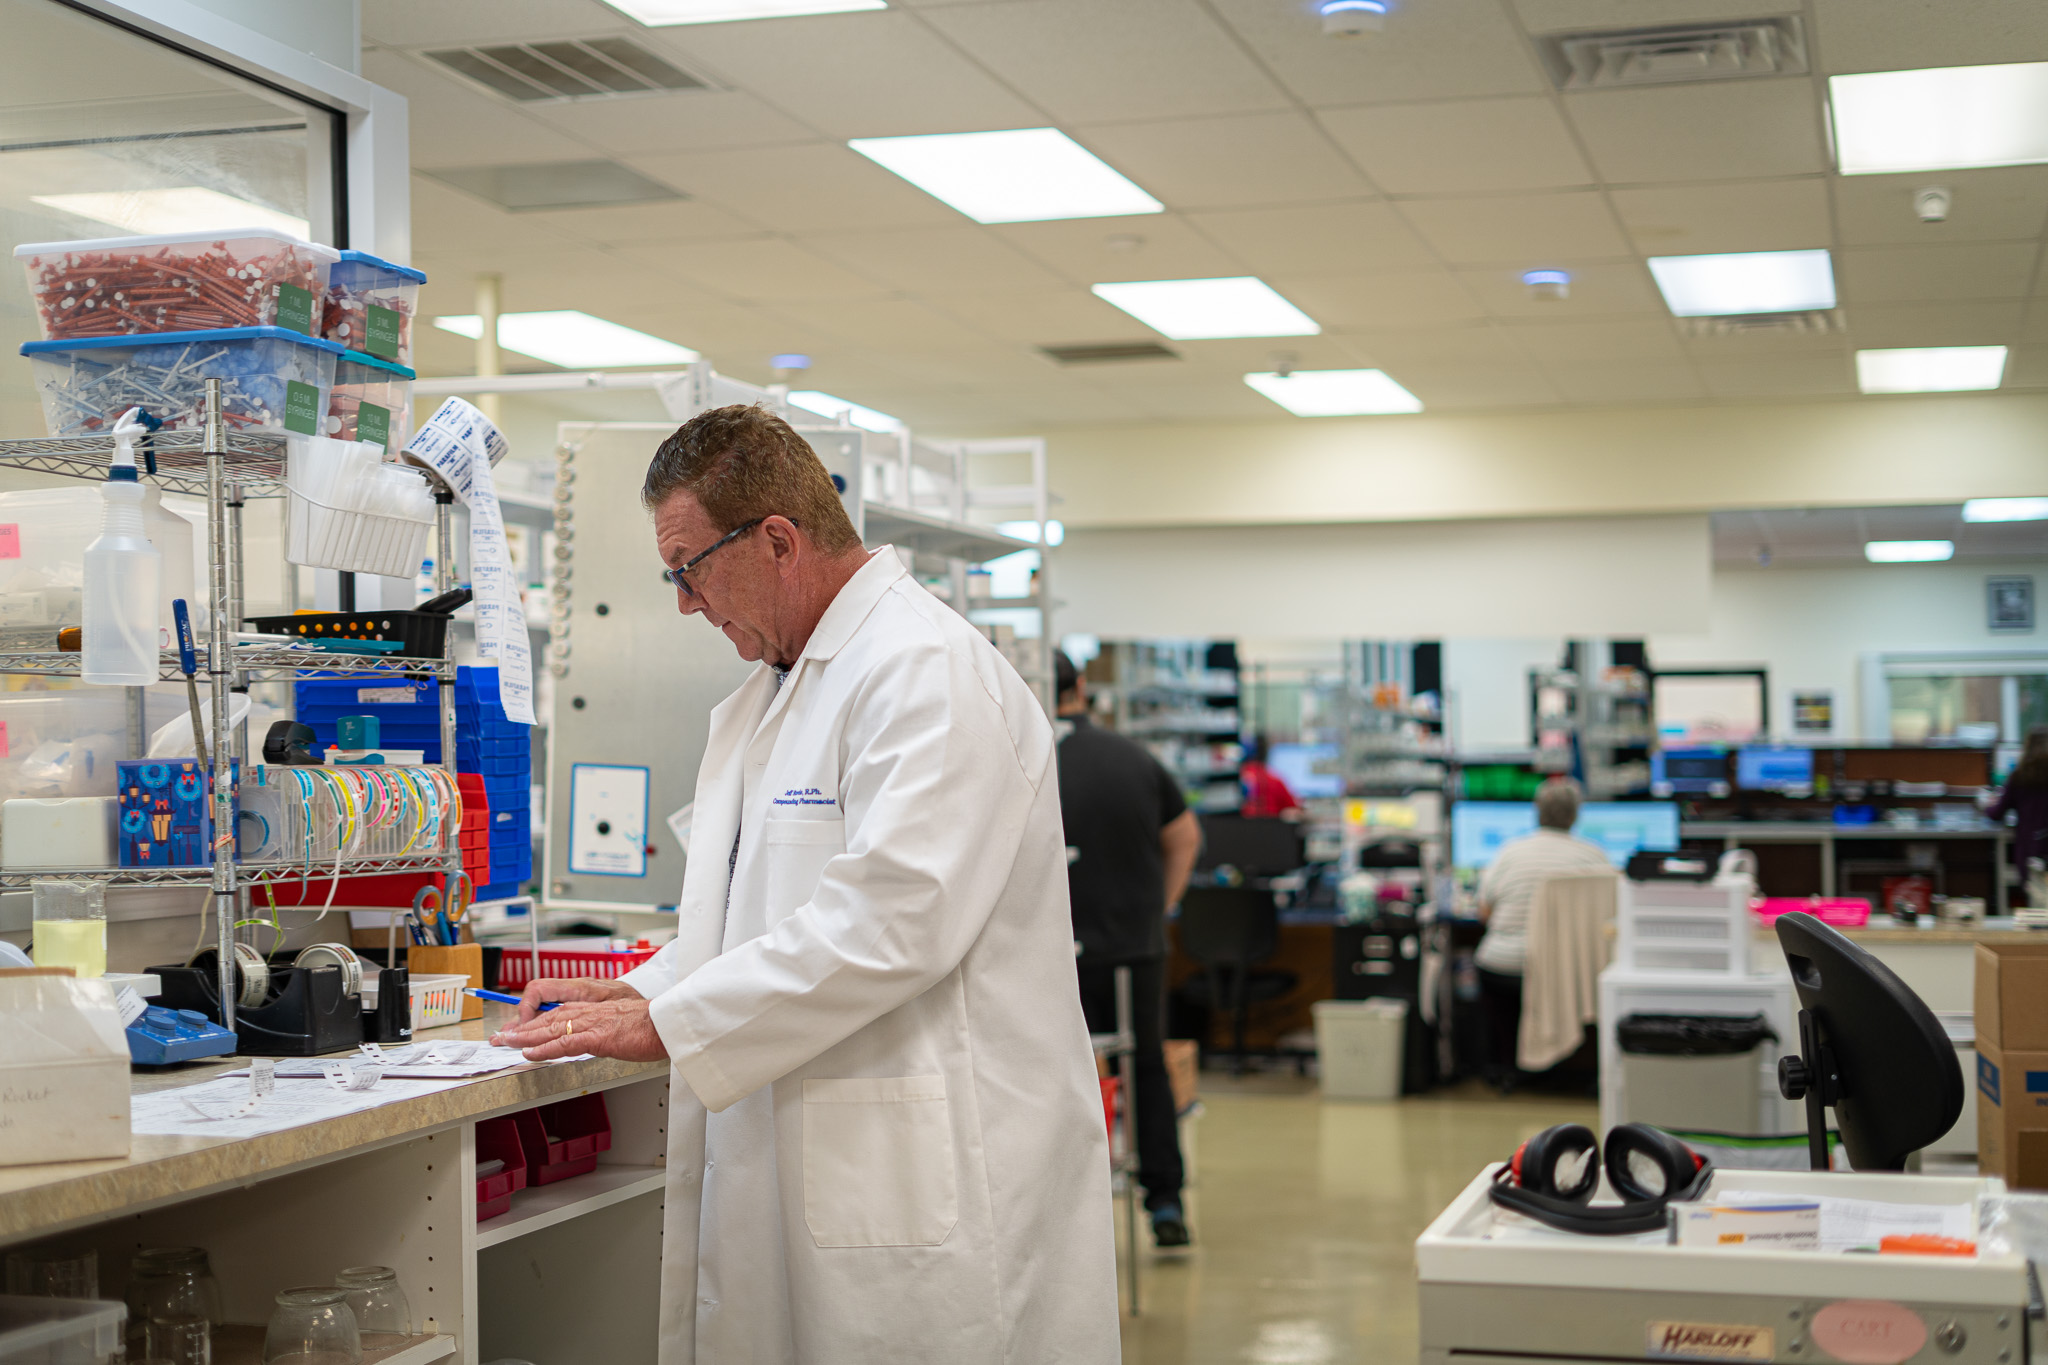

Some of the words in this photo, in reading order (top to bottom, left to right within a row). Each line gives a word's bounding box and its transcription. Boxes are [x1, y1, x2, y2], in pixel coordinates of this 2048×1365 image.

[279, 306, 308, 325] SYRINGES
[368, 327, 397, 343] SYRINGES
[303, 394, 312, 406] ML
[286, 404, 316, 420] SYRINGES
[435, 401, 455, 421] PARAFILM
[358, 424, 387, 440] SYRINGES
[409, 427, 431, 449] PARAFILM
[436, 445, 459, 467] PARAFILM
[1661, 1325, 1756, 1350] HARLOFF
[1840, 1319, 1894, 1339] CART
